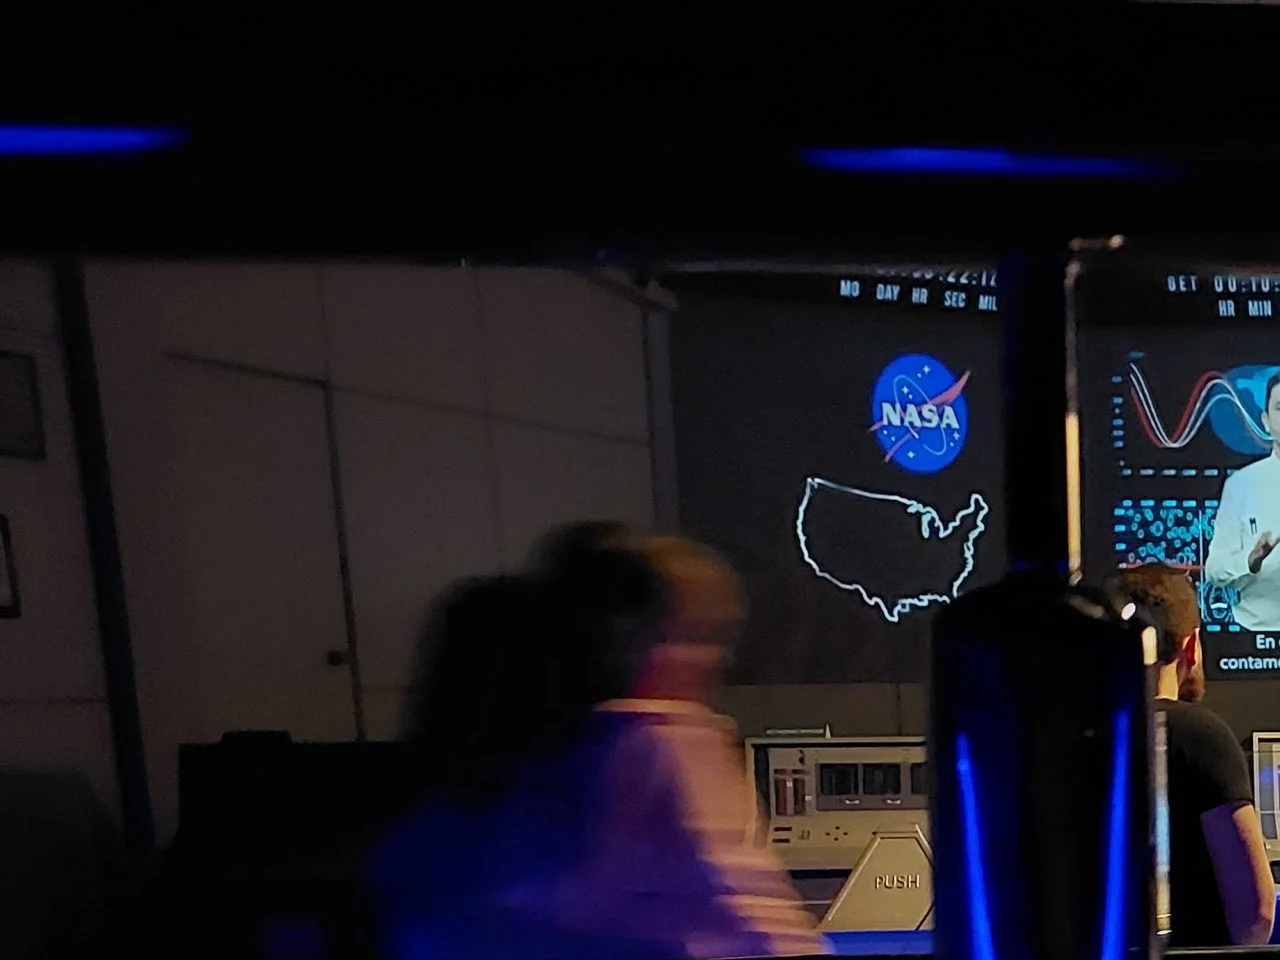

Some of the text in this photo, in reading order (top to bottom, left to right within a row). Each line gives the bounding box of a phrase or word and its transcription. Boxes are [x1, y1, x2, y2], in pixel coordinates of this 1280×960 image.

[840, 279, 860, 297] MO
[876, 284, 900, 301] DAY
[912, 287, 928, 304] HR
[944, 290, 966, 308] SEC
[1218, 299, 1235, 317] HR
[1248, 299, 1272, 317] MIN
[881, 402, 960, 429] NASA
[1256, 634, 1276, 650] En
[875, 874, 921, 890] PUSH
